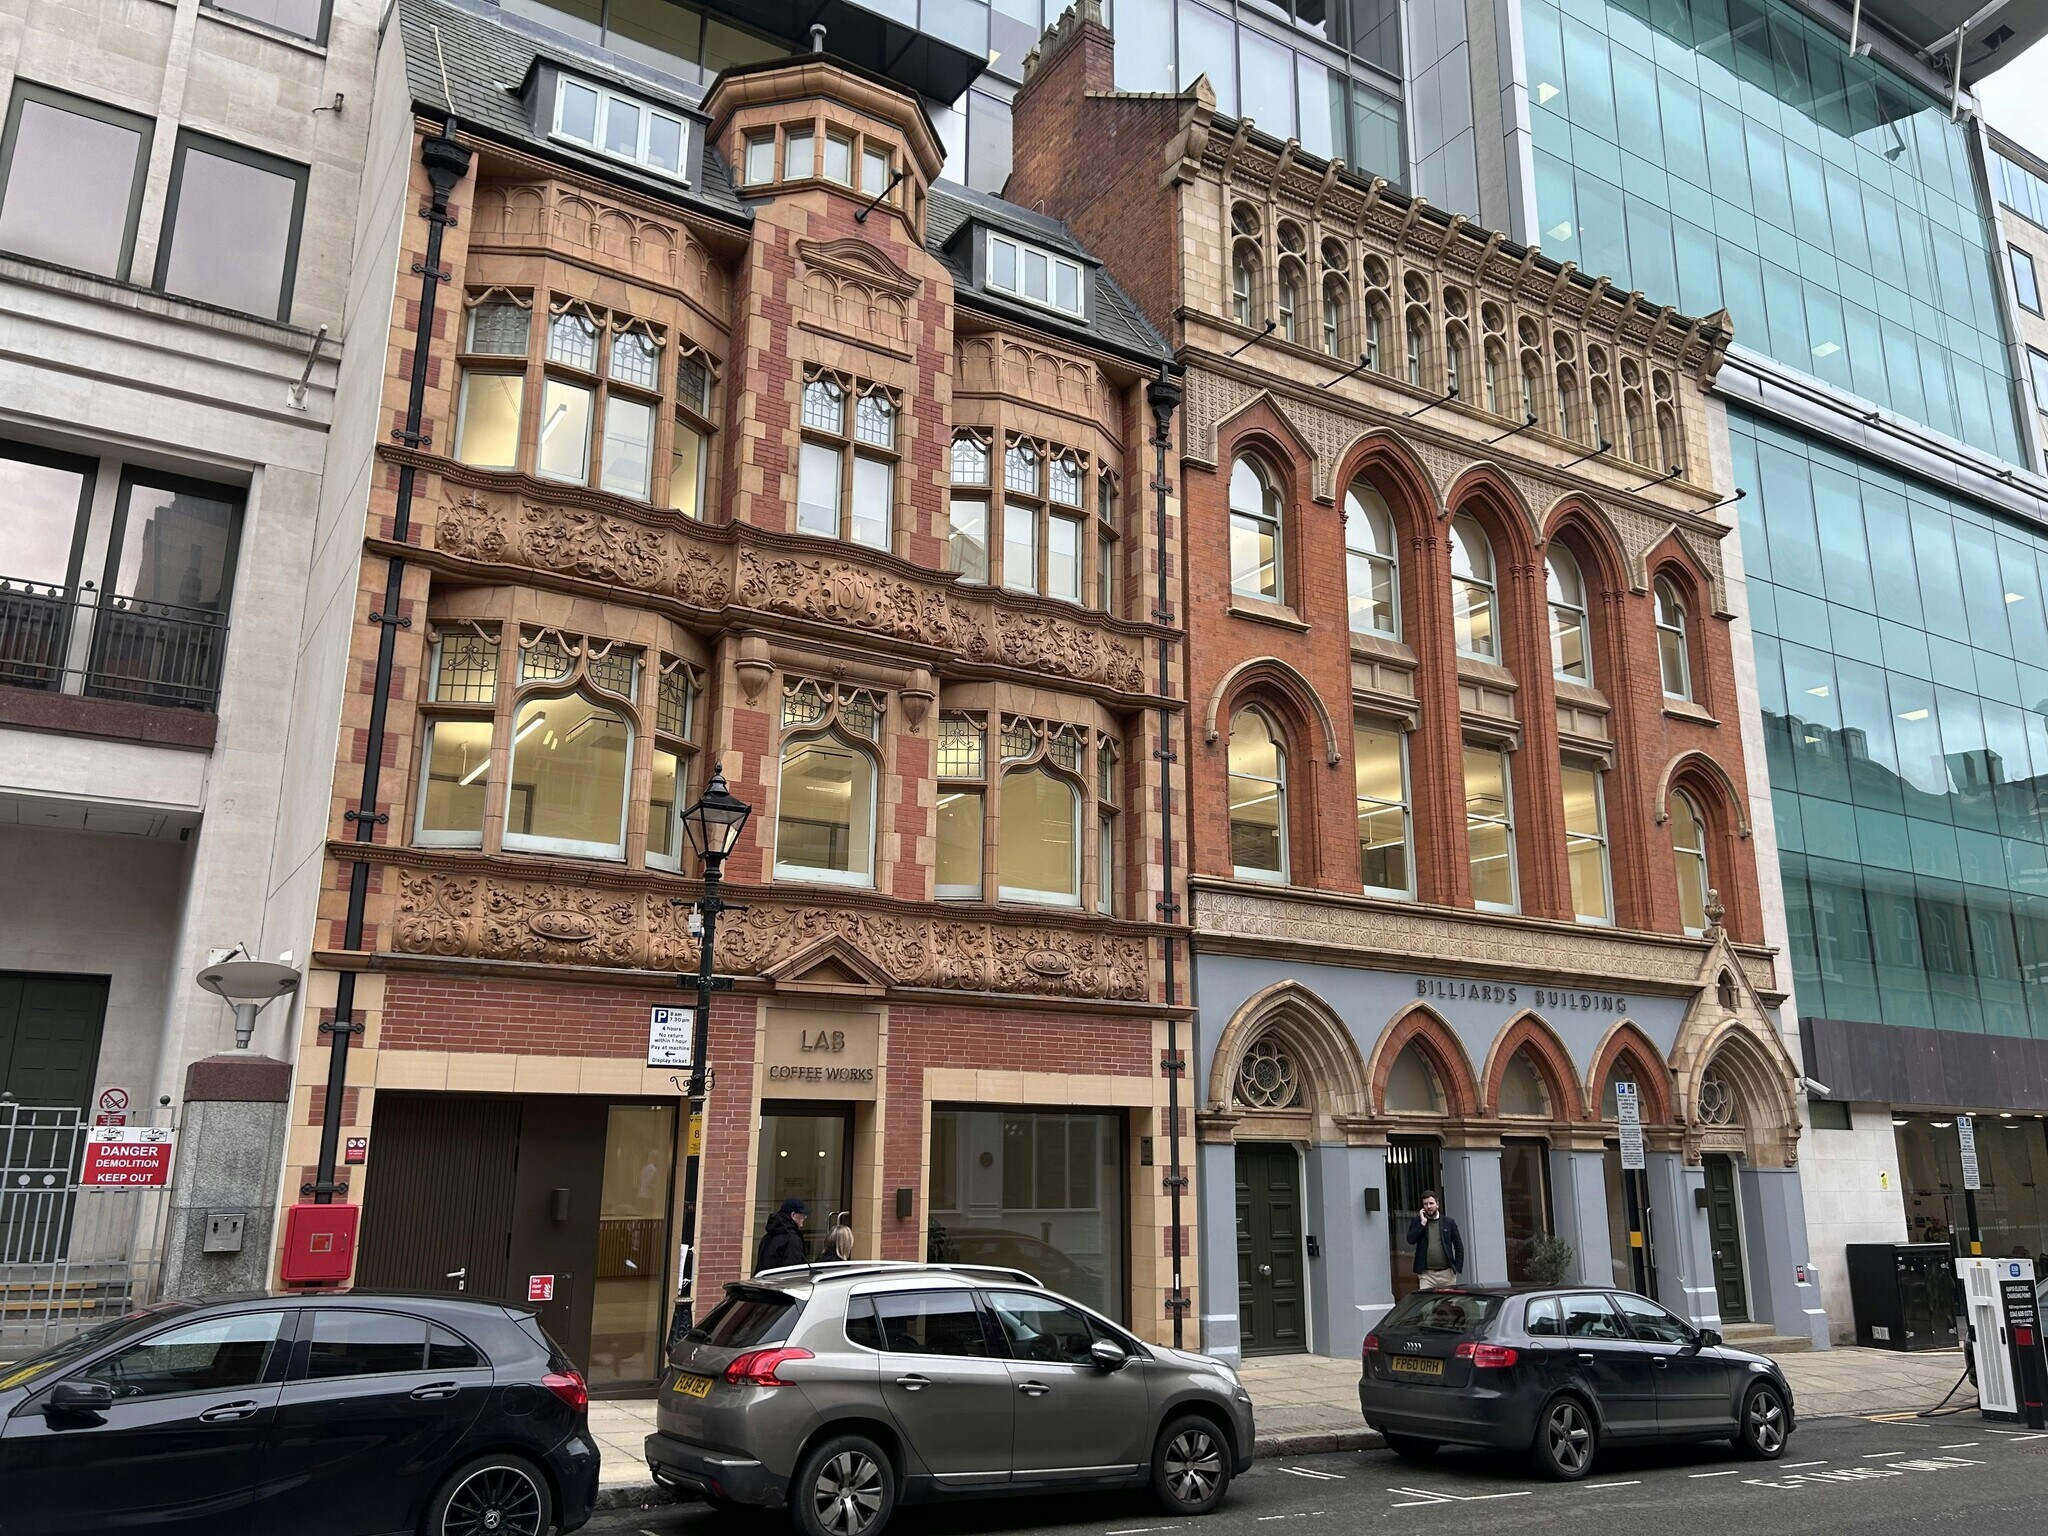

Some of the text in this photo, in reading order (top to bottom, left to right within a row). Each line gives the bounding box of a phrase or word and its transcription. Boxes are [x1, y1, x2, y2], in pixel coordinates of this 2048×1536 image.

[1416, 979, 1627, 1012] BILLIARDS BUILDING
[801, 1029, 845, 1052] LAB
[769, 1065, 874, 1082] COFFEE WORKS
[100, 1145, 158, 1157] DANGER
[95, 1159, 159, 1168] DEMOLITION
[97, 1173, 153, 1182] KEEP OUT
[1395, 1357, 1419, 1370] FP60
